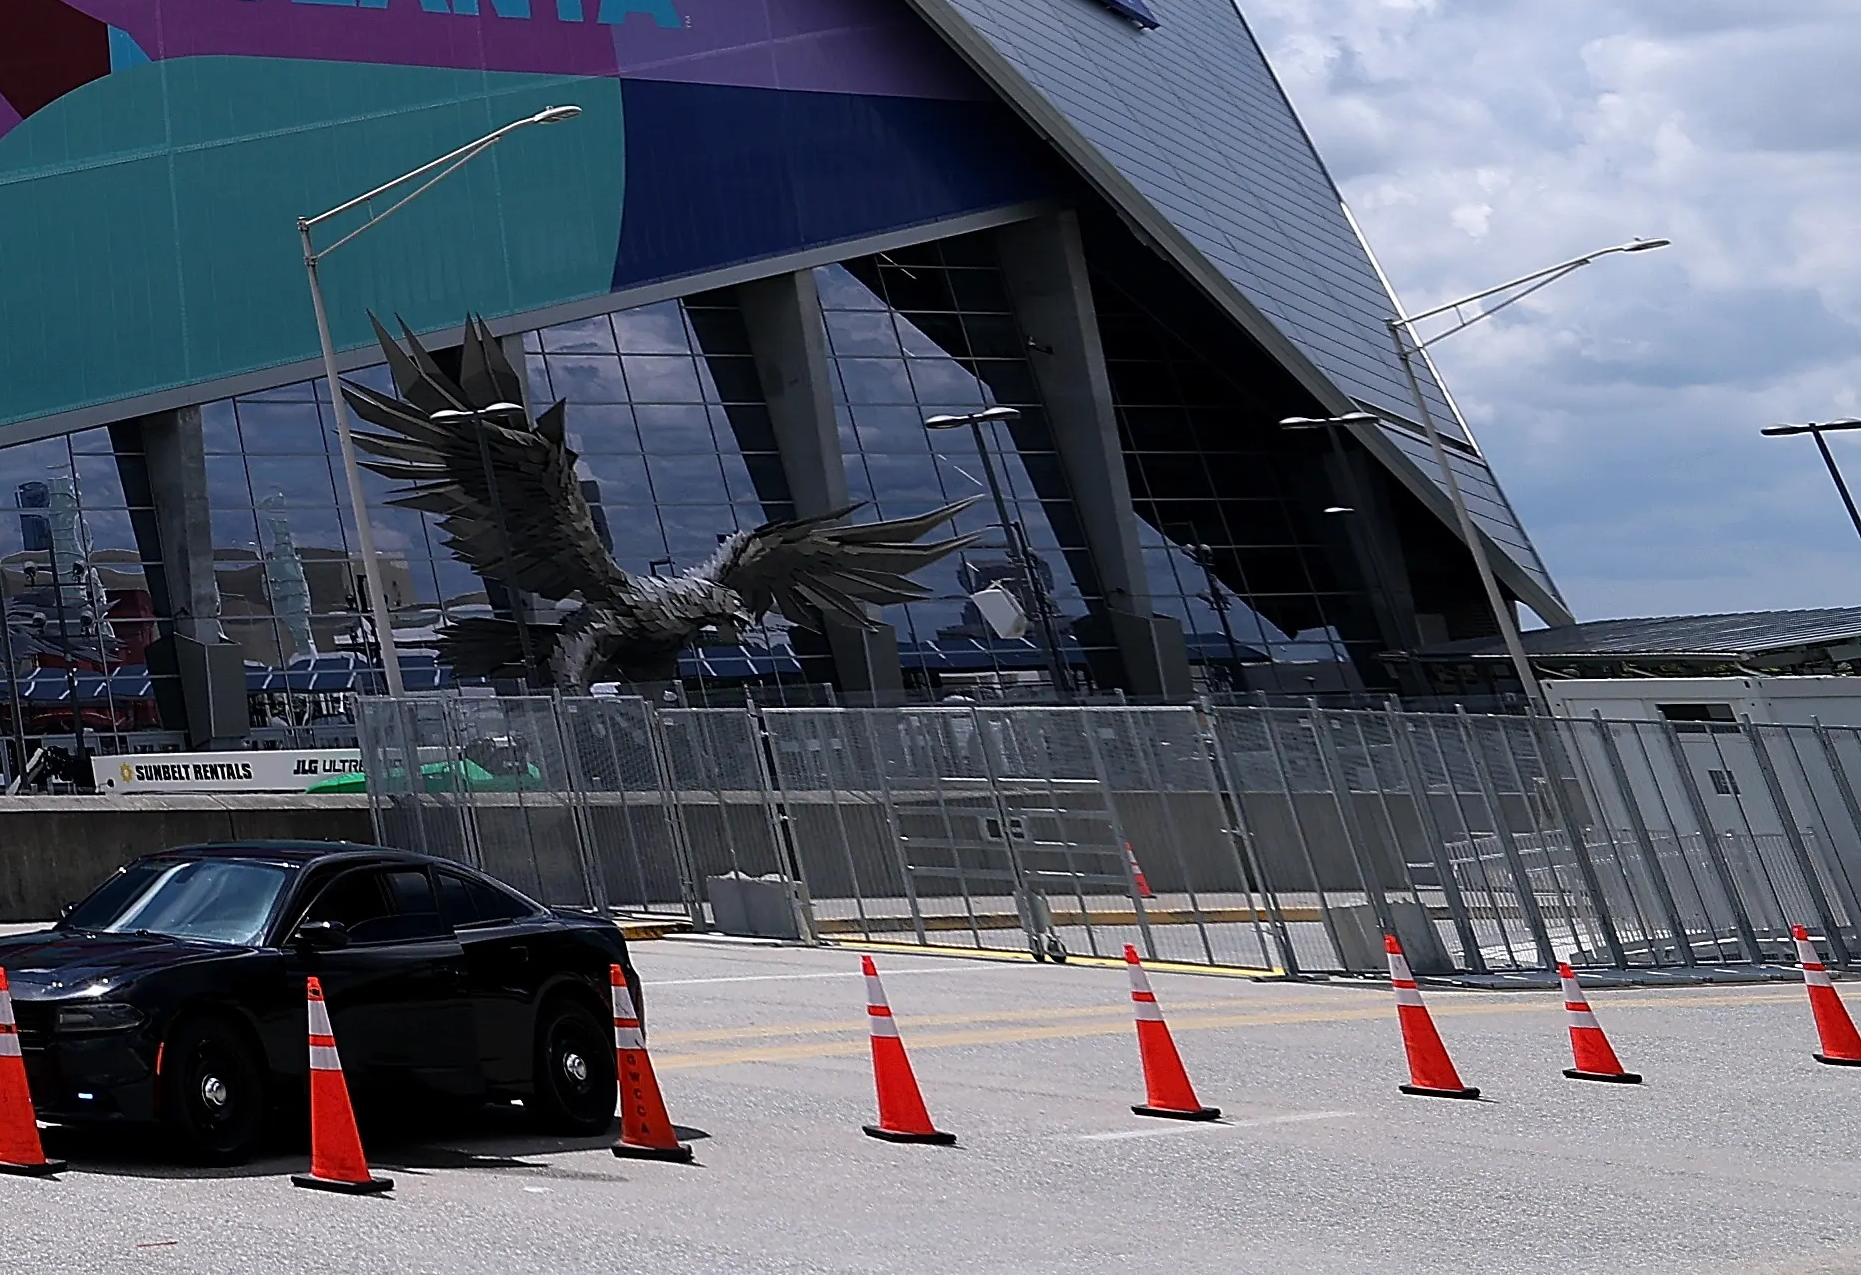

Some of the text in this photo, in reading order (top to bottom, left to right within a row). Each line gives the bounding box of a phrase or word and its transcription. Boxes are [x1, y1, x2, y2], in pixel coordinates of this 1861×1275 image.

[136, 762, 252, 781] SUNBELT RENTALS
[293, 760, 318, 775] JLG
